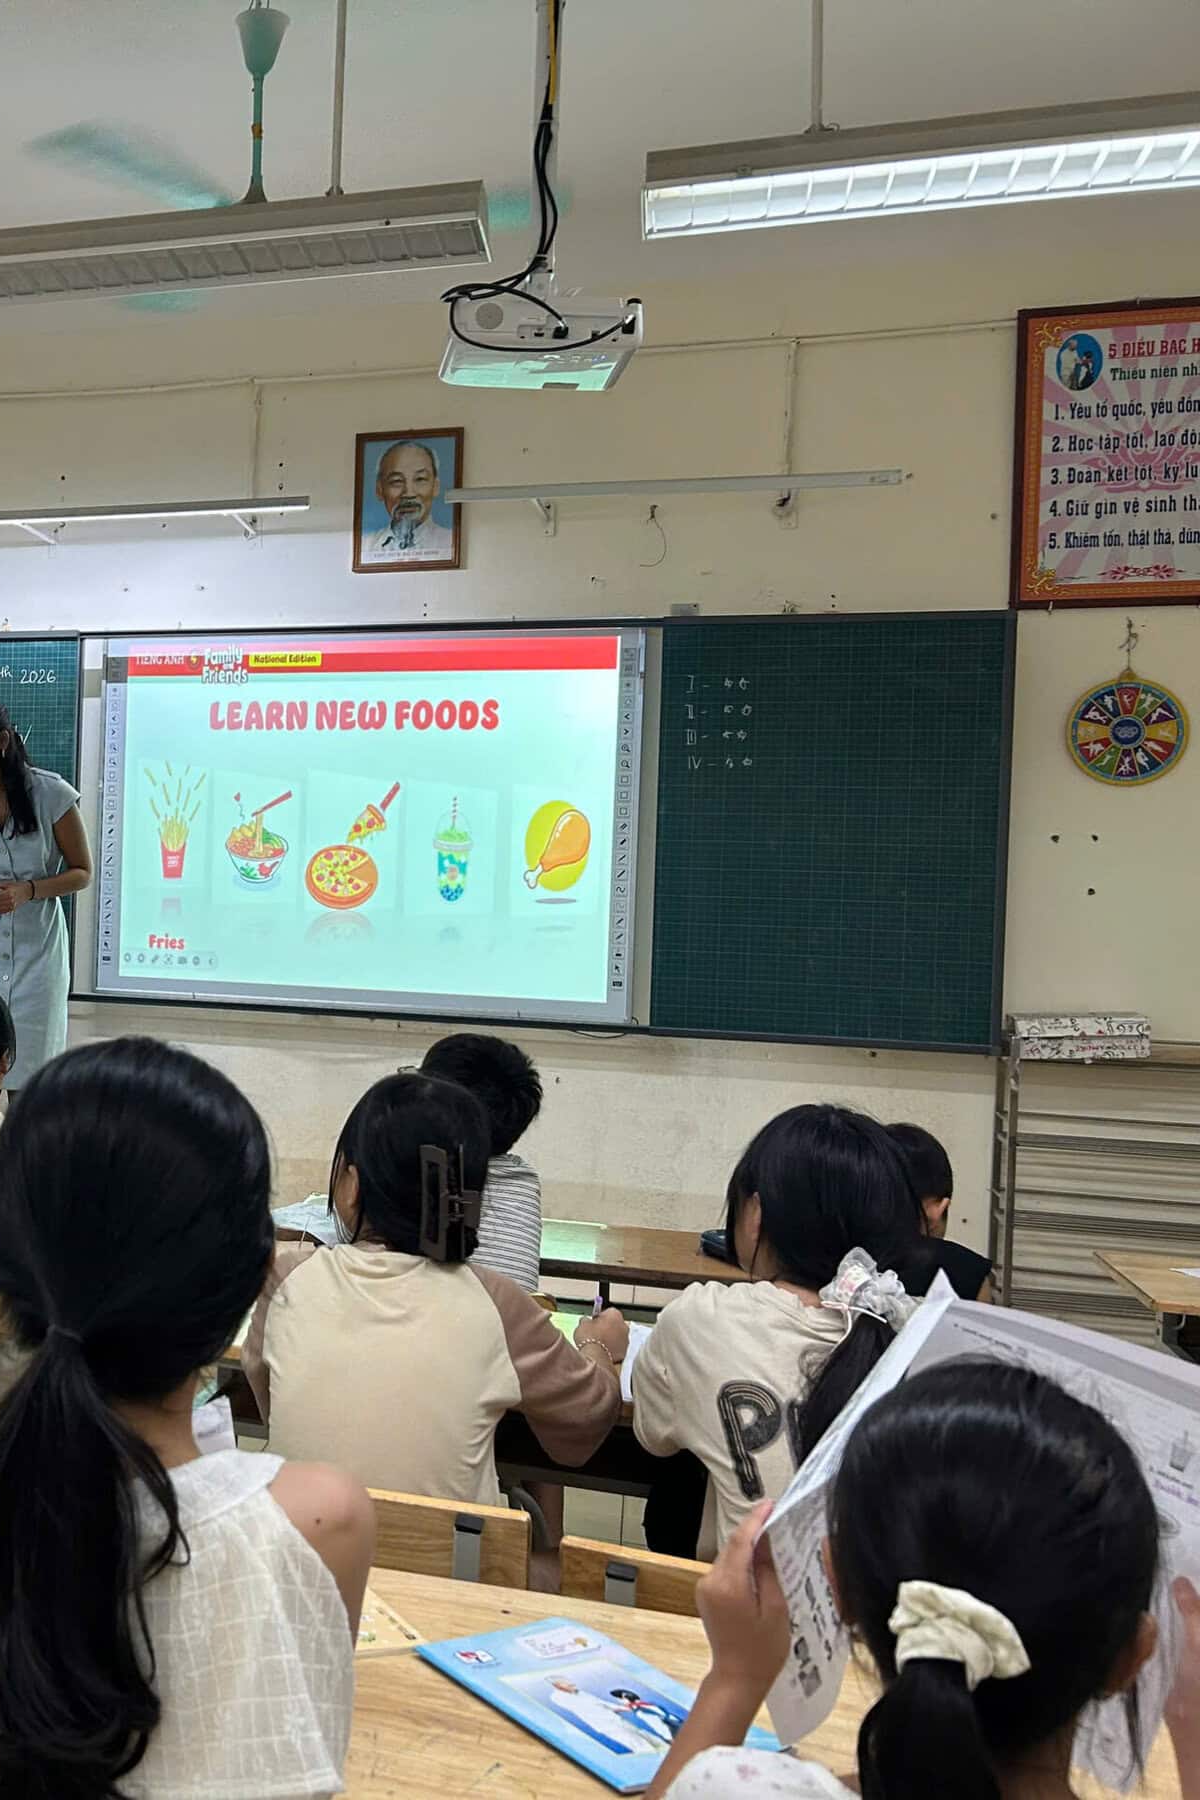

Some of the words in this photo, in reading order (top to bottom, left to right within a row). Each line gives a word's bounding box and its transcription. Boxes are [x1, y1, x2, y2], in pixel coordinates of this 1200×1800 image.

[1108, 343, 1117, 359] 5
[1054, 404, 1065, 420] 1.
[1070, 399, 1091, 419] Yêu
[1151, 398, 1172, 419] yêu
[1052, 436, 1064, 453] 2.
[1068, 434, 1093, 454] Học
[1154, 430, 1175, 447] lao
[1051, 468, 1062, 485] 3.
[1050, 500, 1062, 517] 4.
[1145, 495, 1176, 513] sinh
[1048, 532, 1060, 549] 5.
[204, 643, 244, 667] Family
[254, 654, 287, 664] National
[288, 653, 317, 663] Edition
[20, 669, 56, 684] 2026
[201, 668, 249, 685] Friends
[209, 700, 309, 731] LEARN
[315, 699, 388, 731] NEW
[394, 699, 500, 730] FOODS
[148, 932, 185, 950] Fries
